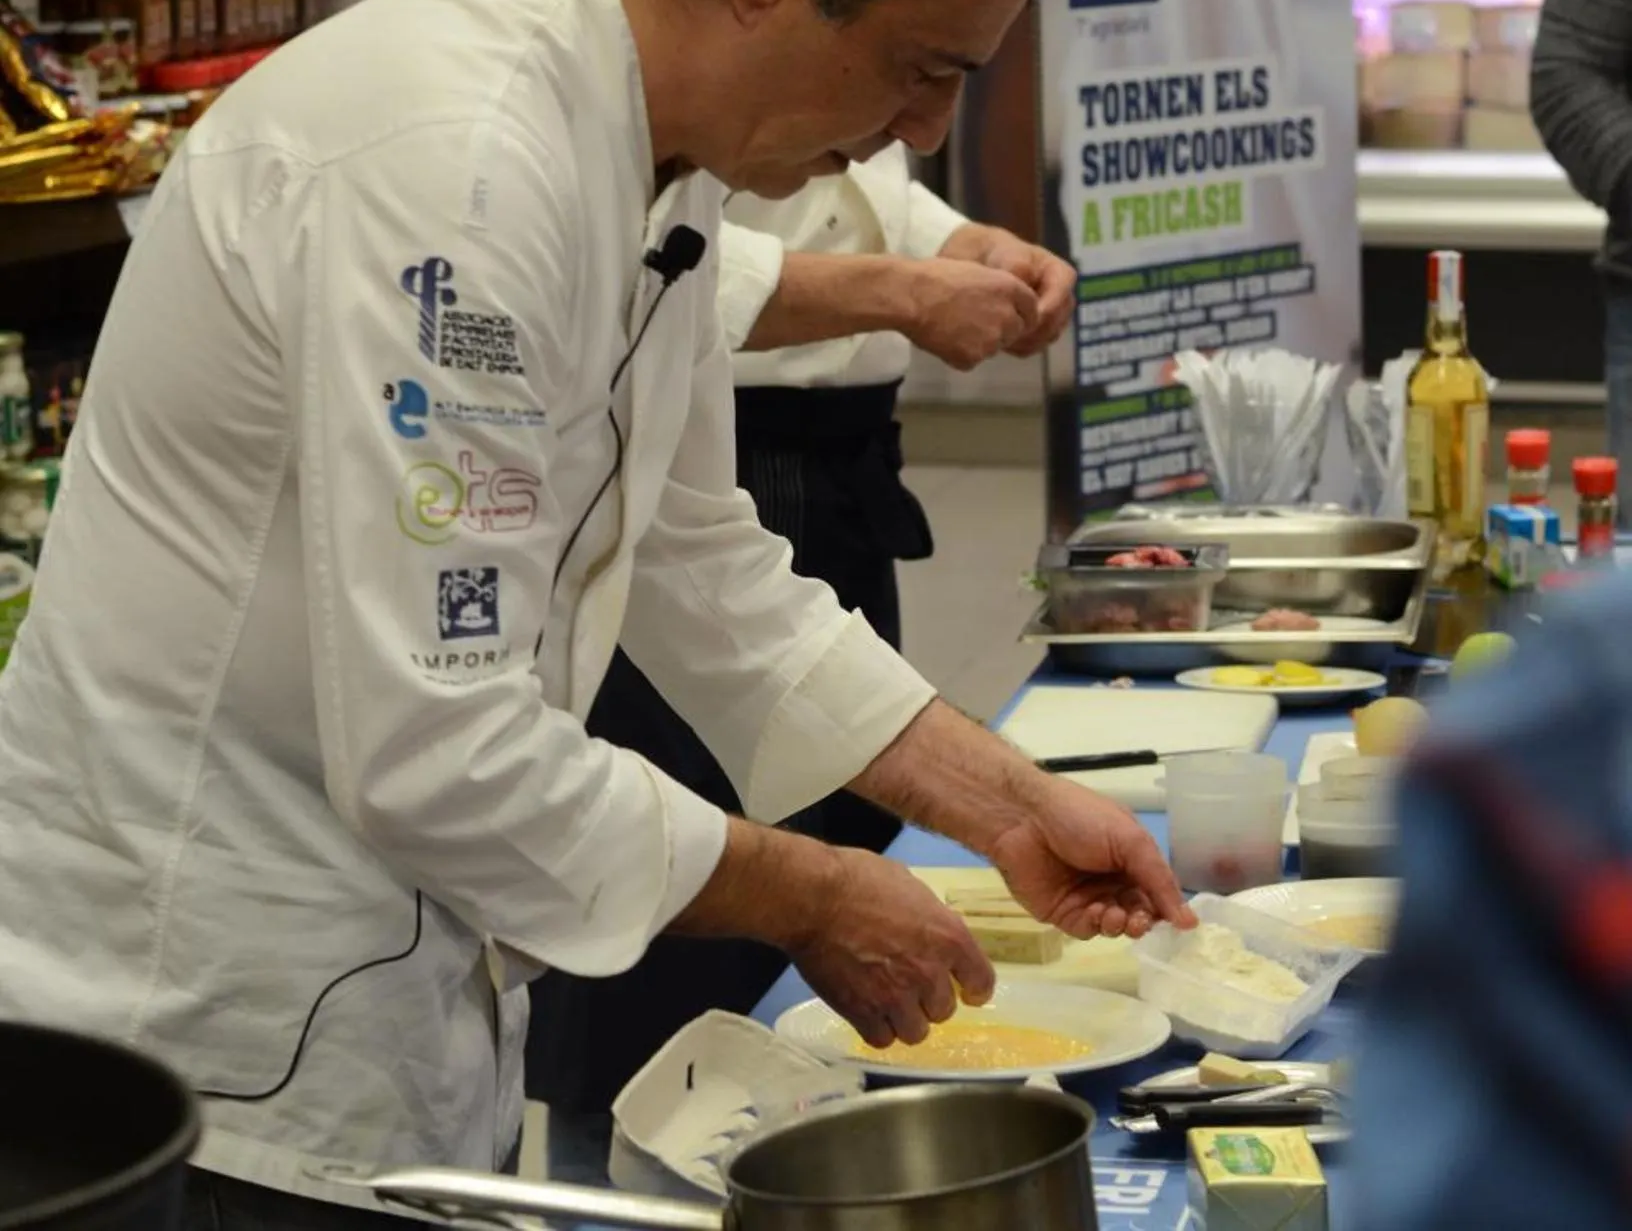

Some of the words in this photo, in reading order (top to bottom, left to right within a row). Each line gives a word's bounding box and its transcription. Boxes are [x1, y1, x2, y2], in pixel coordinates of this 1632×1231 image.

[1079, 73, 1204, 129] TORNEN
[1214, 66, 1269, 113] ELS
[1082, 116, 1315, 187] SHOWCOOKINGS
[1082, 200, 1103, 246] A
[1112, 180, 1244, 242] FRICASH
